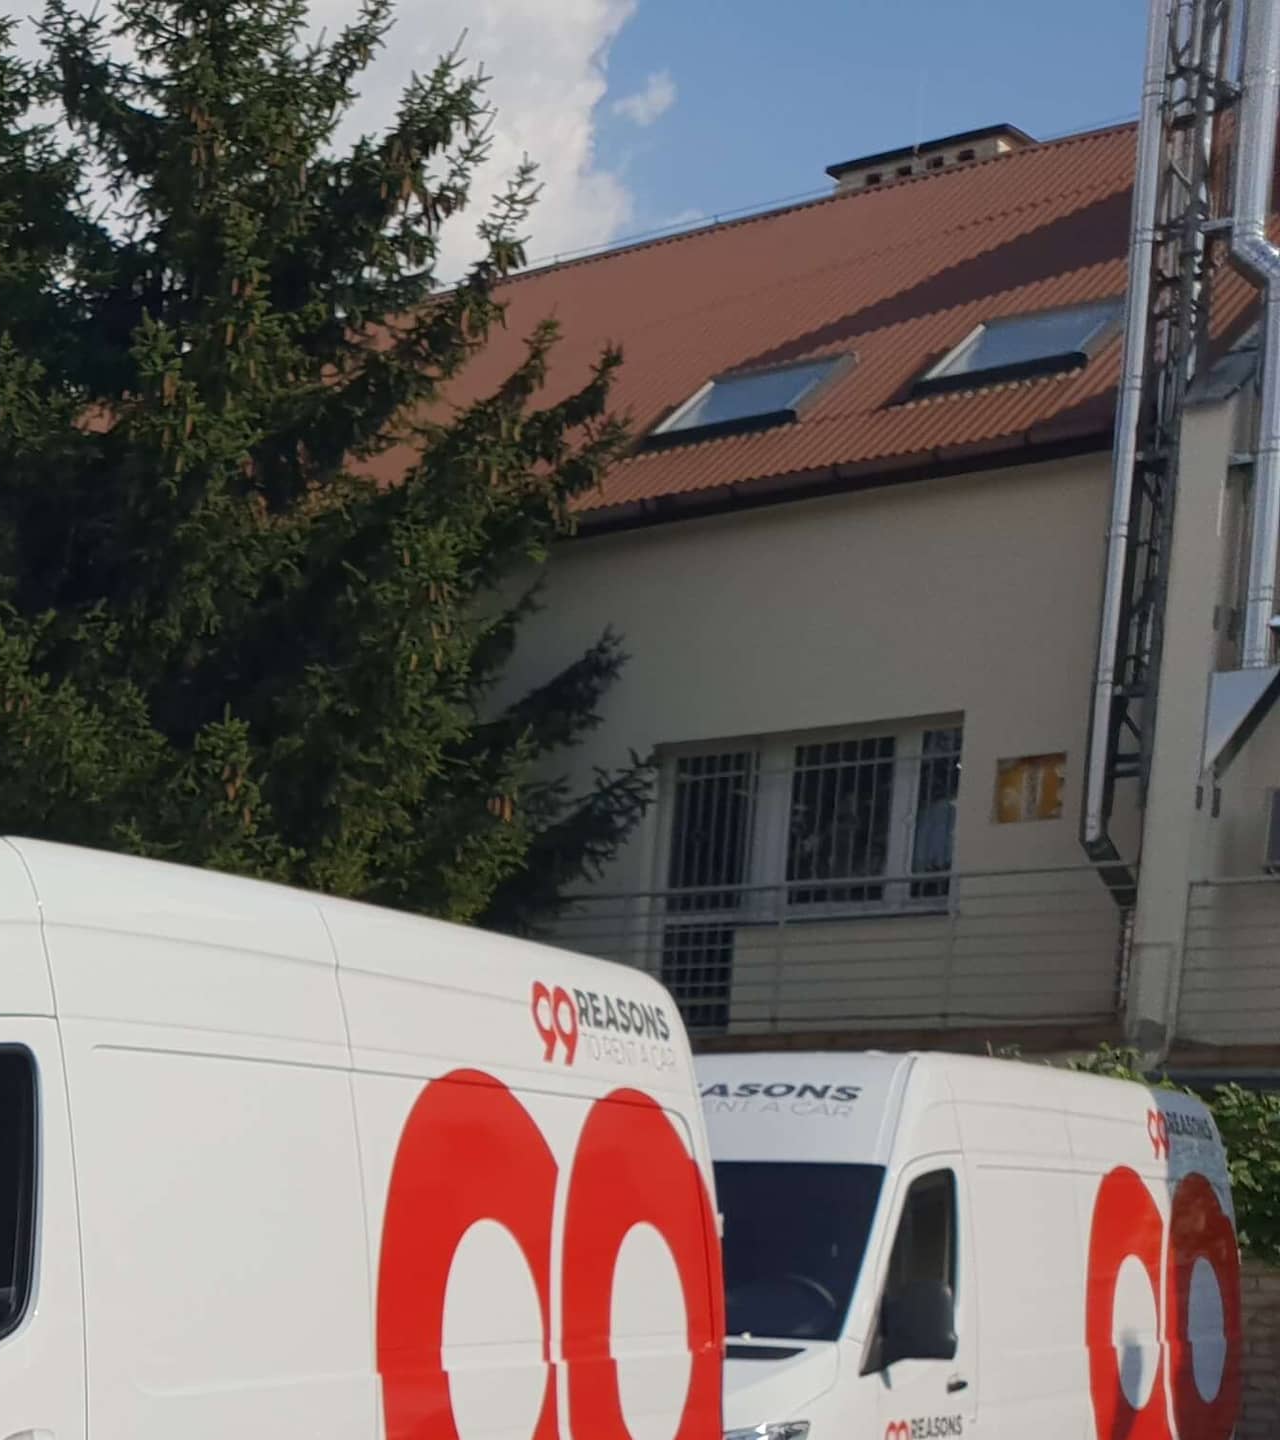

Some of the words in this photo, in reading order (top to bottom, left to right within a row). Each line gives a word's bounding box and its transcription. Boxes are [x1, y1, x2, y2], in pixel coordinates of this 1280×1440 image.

[532, 980, 578, 1067] 99
[573, 988, 671, 1041] REASONS
[698, 1083, 862, 1101] ASONS
